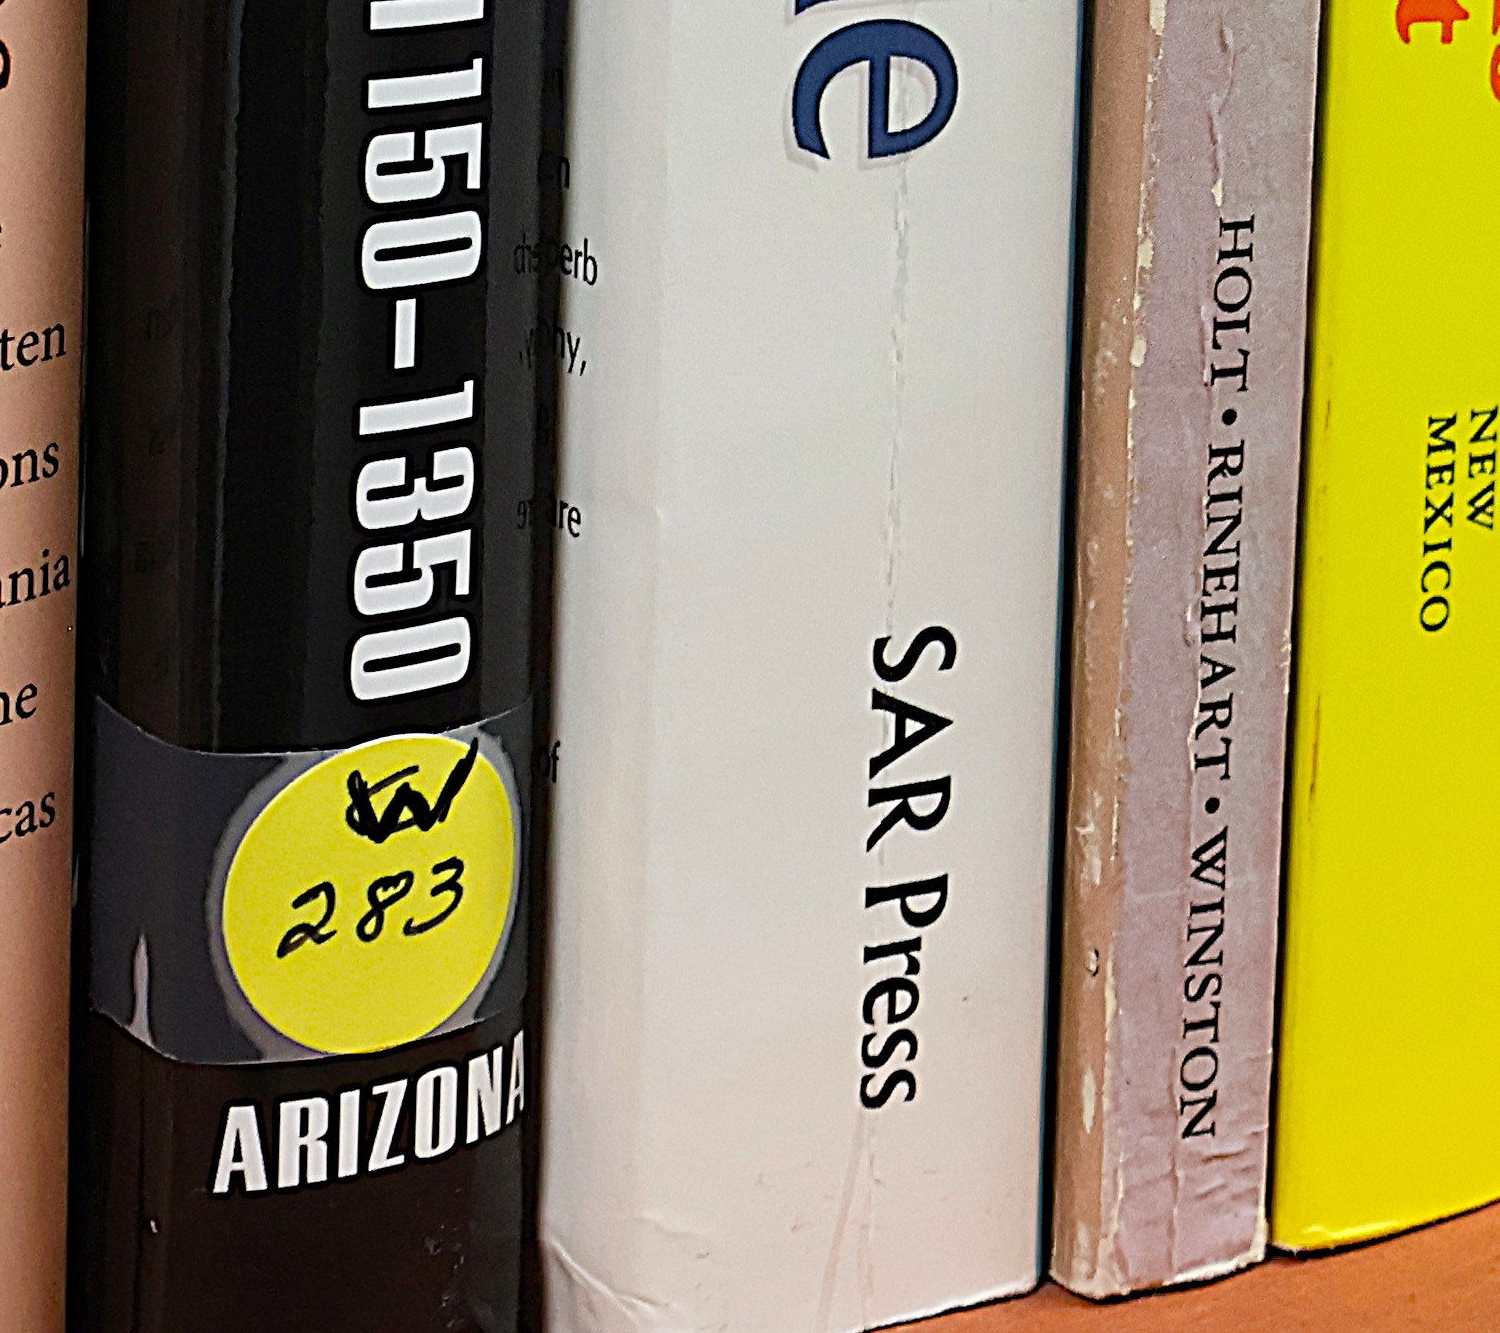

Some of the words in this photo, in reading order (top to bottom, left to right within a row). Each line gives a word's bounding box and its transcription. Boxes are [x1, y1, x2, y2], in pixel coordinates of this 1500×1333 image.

[1210, 215, 1256, 392] HOLT
[1418, 412, 1458, 634] MEXICO
[1467, 405, 1499, 531] NEW
[1196, 438, 1246, 782] RINEHART
[867, 623, 958, 853] SAR
[278, 857, 465, 958] 283
[859, 872, 949, 1110] Press
[1179, 825, 1231, 1140] WINSTON
[212, 1030, 526, 1195] ARIZONA
